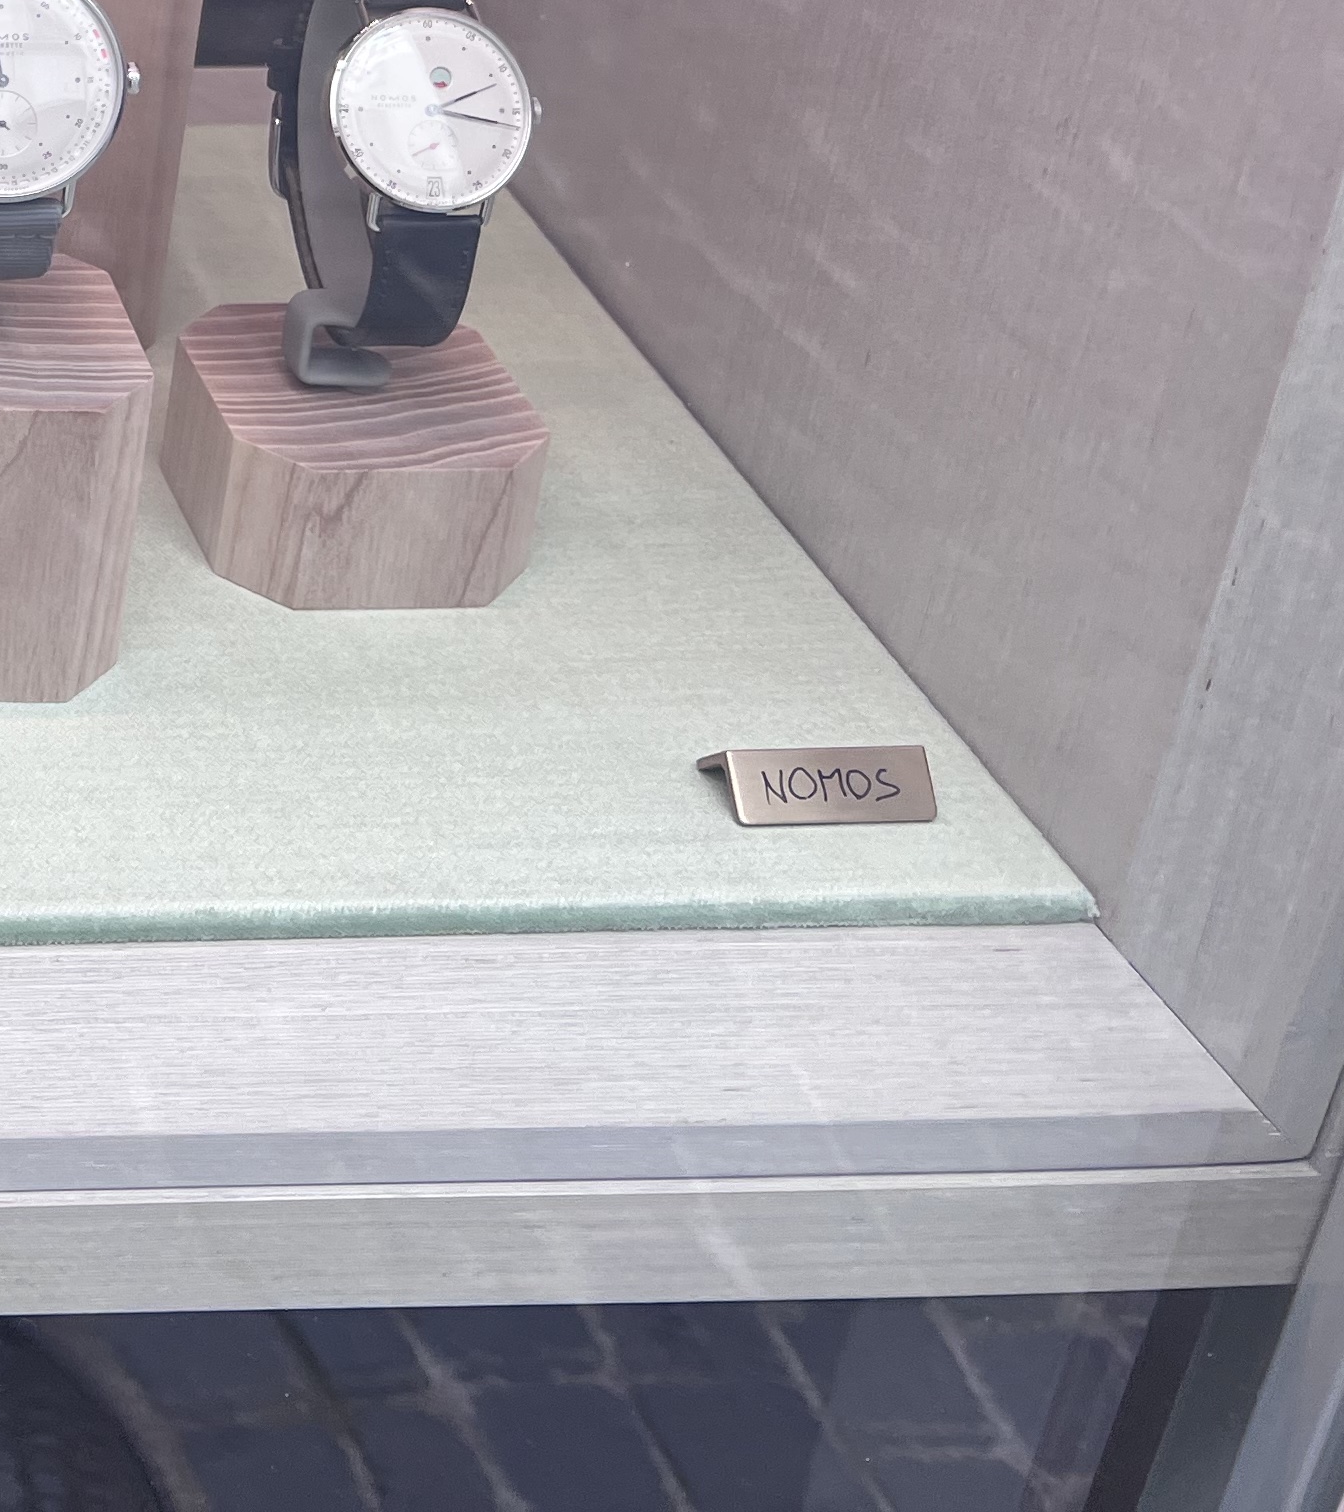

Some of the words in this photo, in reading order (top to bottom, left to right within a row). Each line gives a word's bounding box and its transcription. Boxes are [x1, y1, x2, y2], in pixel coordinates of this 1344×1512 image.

[423, 19, 432, 28] 60
[498, 60, 507, 73] 10
[427, 180, 441, 198] 23
[761, 767, 901, 805] NOMOS
